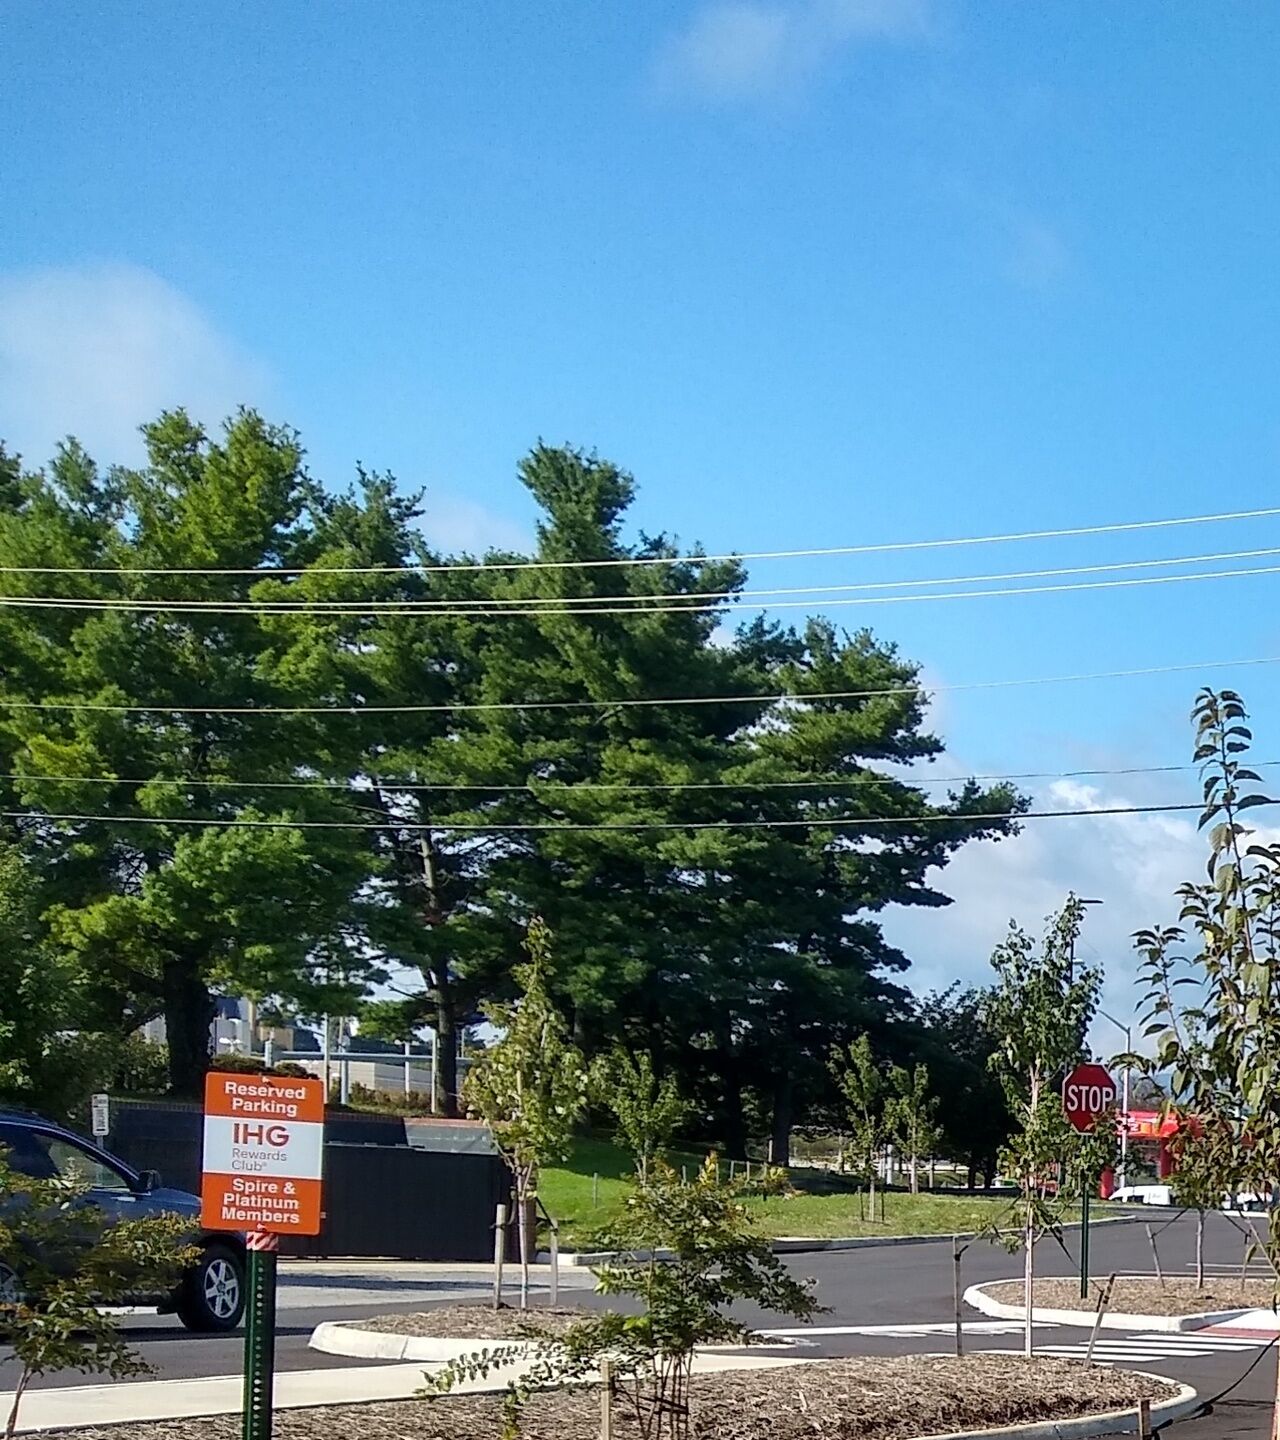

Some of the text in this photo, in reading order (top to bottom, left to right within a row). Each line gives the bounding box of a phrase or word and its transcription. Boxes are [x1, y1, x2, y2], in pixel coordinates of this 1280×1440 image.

[224, 1081, 306, 1100] Reserved
[1066, 1084, 1114, 1113] STOP
[232, 1097, 298, 1117] Parking
[233, 1123, 290, 1147] IHG
[232, 1148, 287, 1162] Rewards
[232, 1178, 296, 1195] Spire &
[223, 1192, 299, 1210] Platinum
[222, 1207, 300, 1224] Members
